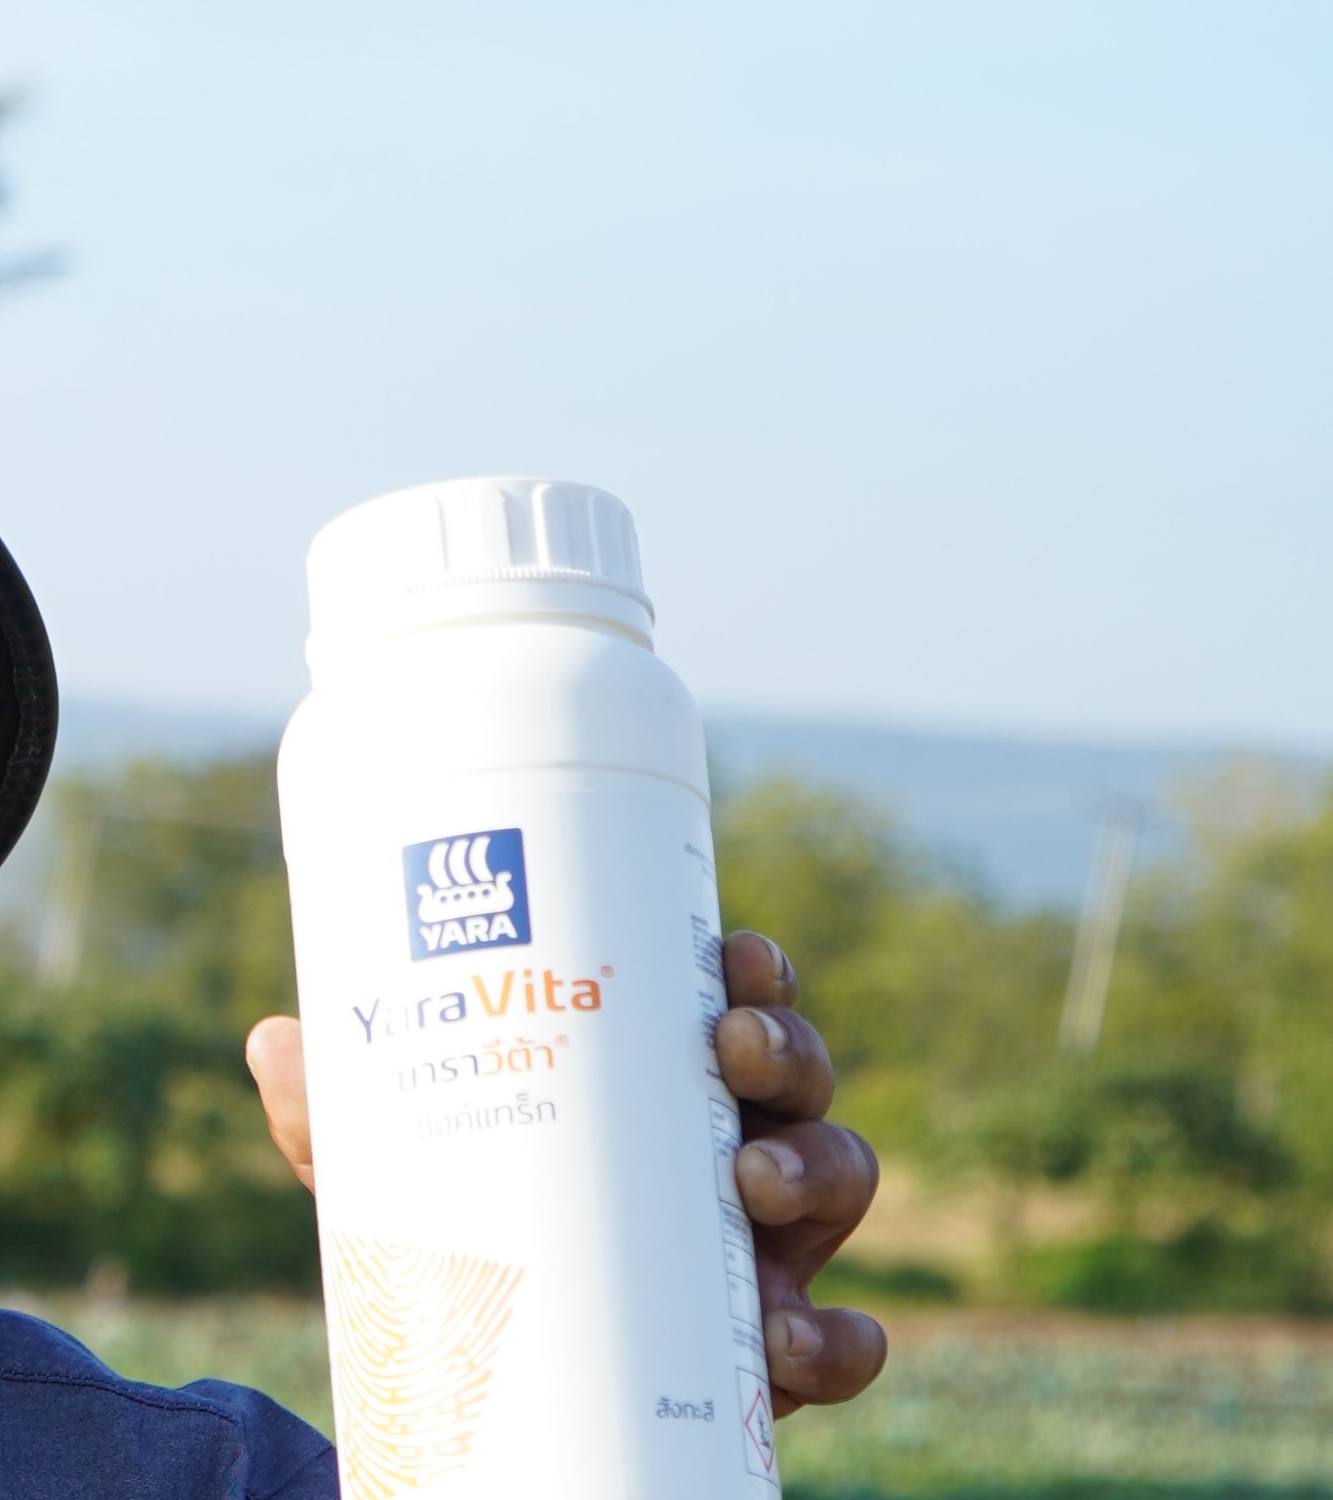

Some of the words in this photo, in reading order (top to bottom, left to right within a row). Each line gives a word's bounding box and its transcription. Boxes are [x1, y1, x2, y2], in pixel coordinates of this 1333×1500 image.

[418, 913, 518, 952] YARA
[655, 1396, 715, 1422] สังกะสี
